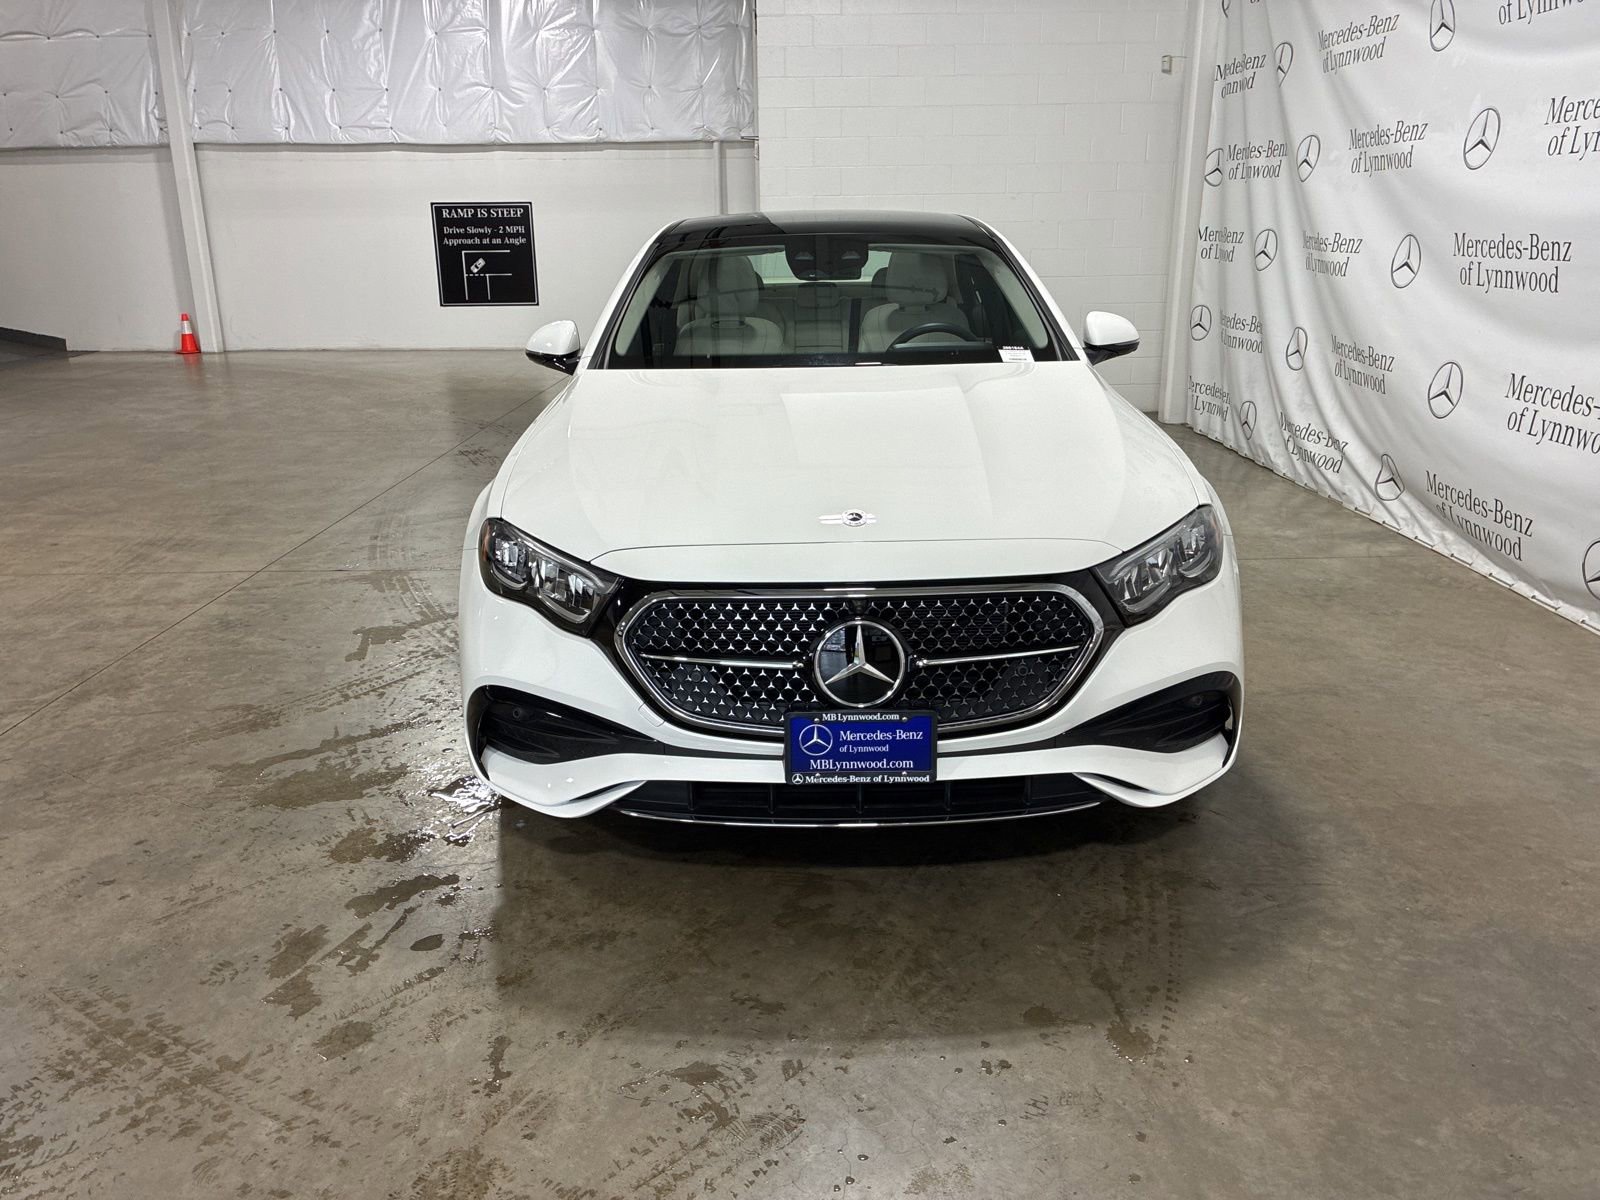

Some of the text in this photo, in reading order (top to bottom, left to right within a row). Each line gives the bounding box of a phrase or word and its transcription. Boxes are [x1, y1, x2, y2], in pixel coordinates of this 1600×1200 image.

[1318, 14, 1400, 51] Mercedes-Benz
[1330, 36, 1386, 75] Lynnwood
[1349, 120, 1429, 150] Mercedes-Benz
[1548, 127, 1570, 156] of
[1228, 162, 1240, 180] of
[1351, 145, 1414, 178] of Lynnwood
[441, 207, 524, 218] RAMP IS STEEP
[443, 226, 465, 234] Drive
[466, 226, 493, 235] Slowly
[498, 226, 504, 234] 2
[505, 226, 525, 234] MPH
[443, 237, 481, 246] Approach
[503, 237, 527, 246] Angle
[1201, 243, 1213, 259] of
[1453, 232, 1572, 262] Mercedes-Benz
[1460, 261, 1559, 294] of Lynnwood
[1331, 334, 1395, 372] Mercedes-Benz
[1334, 358, 1386, 395] of Lynnwood
[1507, 406, 1600, 454] of Lynnwo
[1426, 470, 1533, 537] Mercedes-Benz
[839, 729, 923, 741] Mercedes-Benz
[849, 744, 889, 754] Lynnwood
[805, 774, 930, 784] Mercedes-Benz of Lynnwood
[809, 758, 914, 771] MBLynnwood.com
